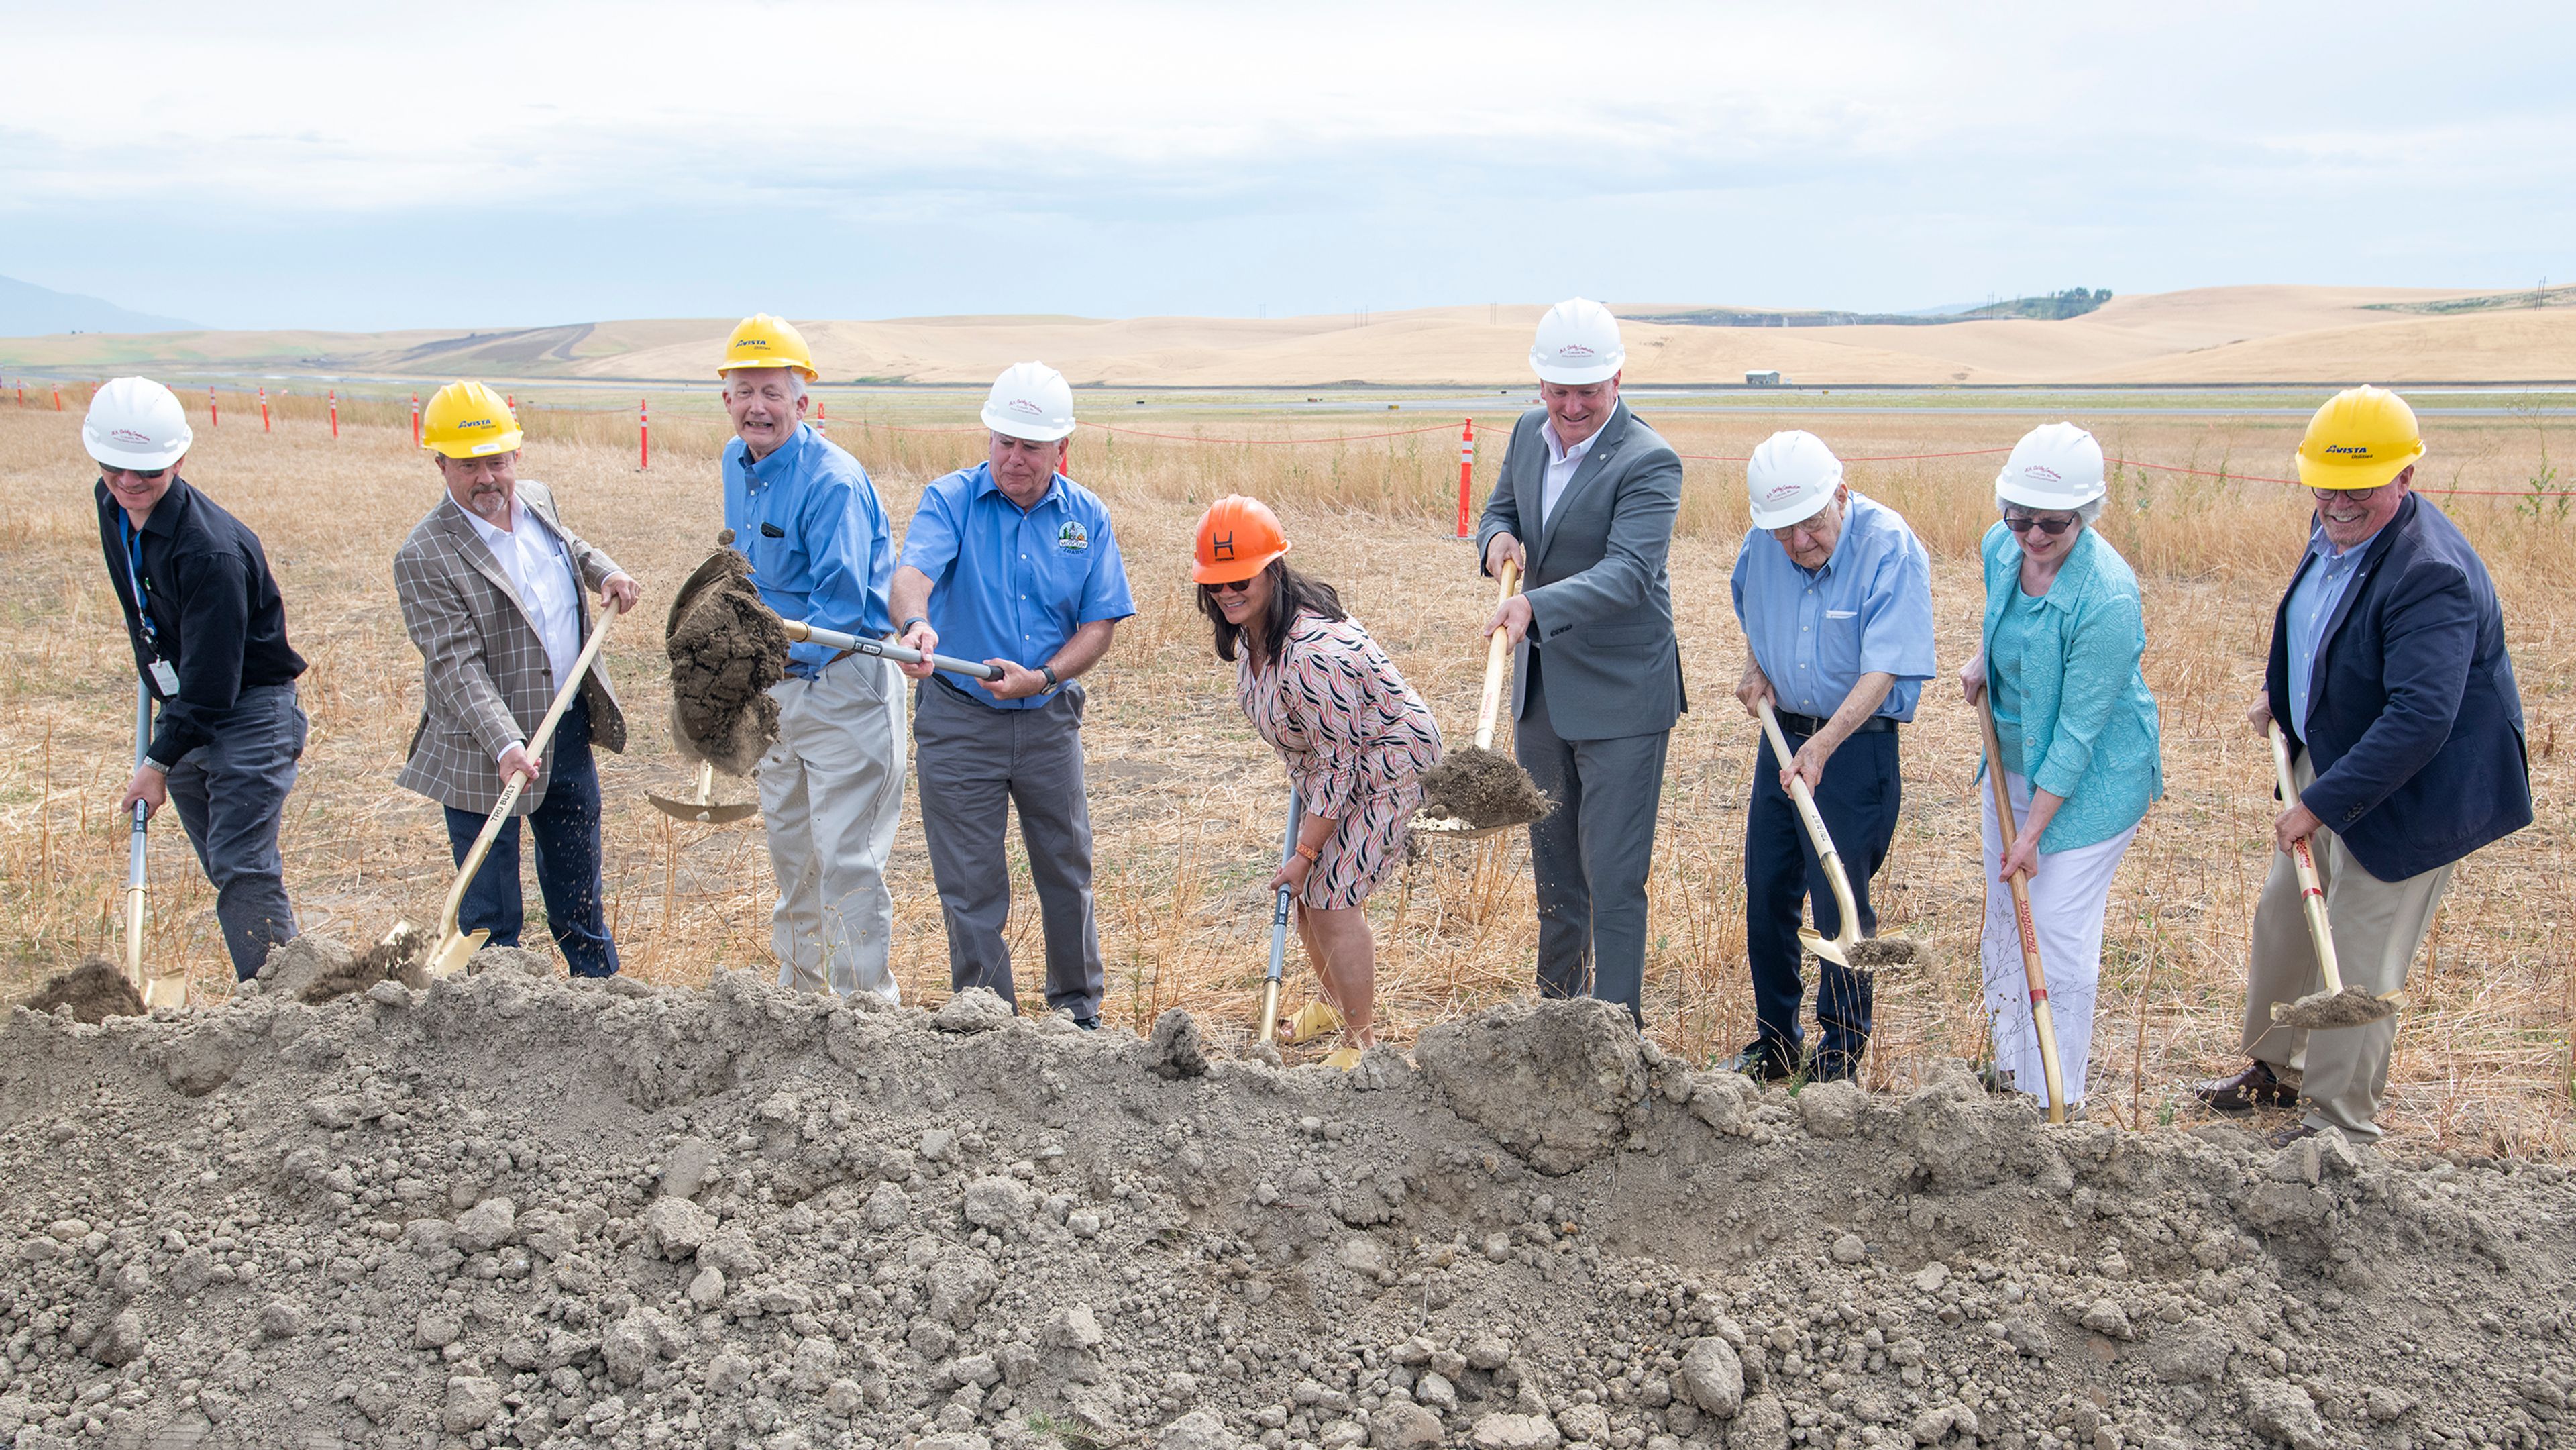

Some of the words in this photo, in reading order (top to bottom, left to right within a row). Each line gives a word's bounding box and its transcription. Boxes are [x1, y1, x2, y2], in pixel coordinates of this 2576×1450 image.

[458, 419, 491, 428] AVISTA
[2325, 444, 2367, 453] AVISTA
[490, 806, 504, 821] TRU
[500, 784, 515, 805] BUILT
